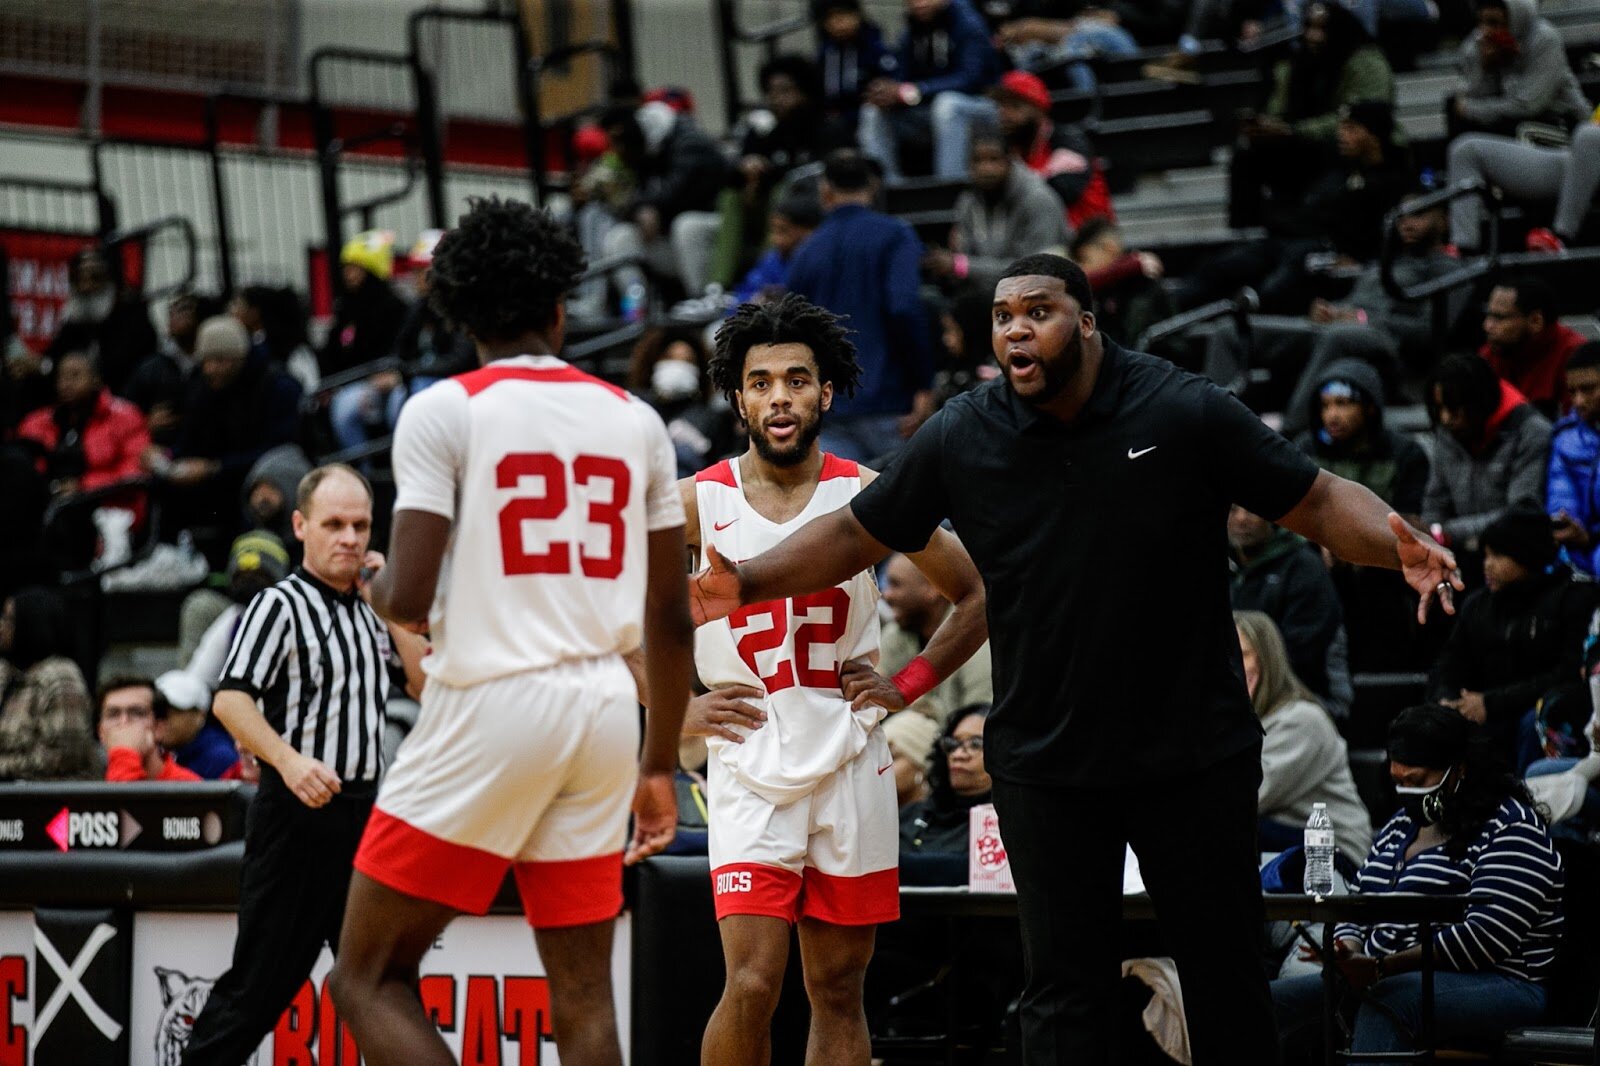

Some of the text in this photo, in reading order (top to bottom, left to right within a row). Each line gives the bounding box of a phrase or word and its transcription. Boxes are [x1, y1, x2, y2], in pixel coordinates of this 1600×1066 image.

[496, 452, 631, 580] 23
[727, 587, 851, 695] 22
[68, 811, 119, 848] POSS
[162, 816, 201, 840] BONUS
[716, 871, 752, 896] BUCS
